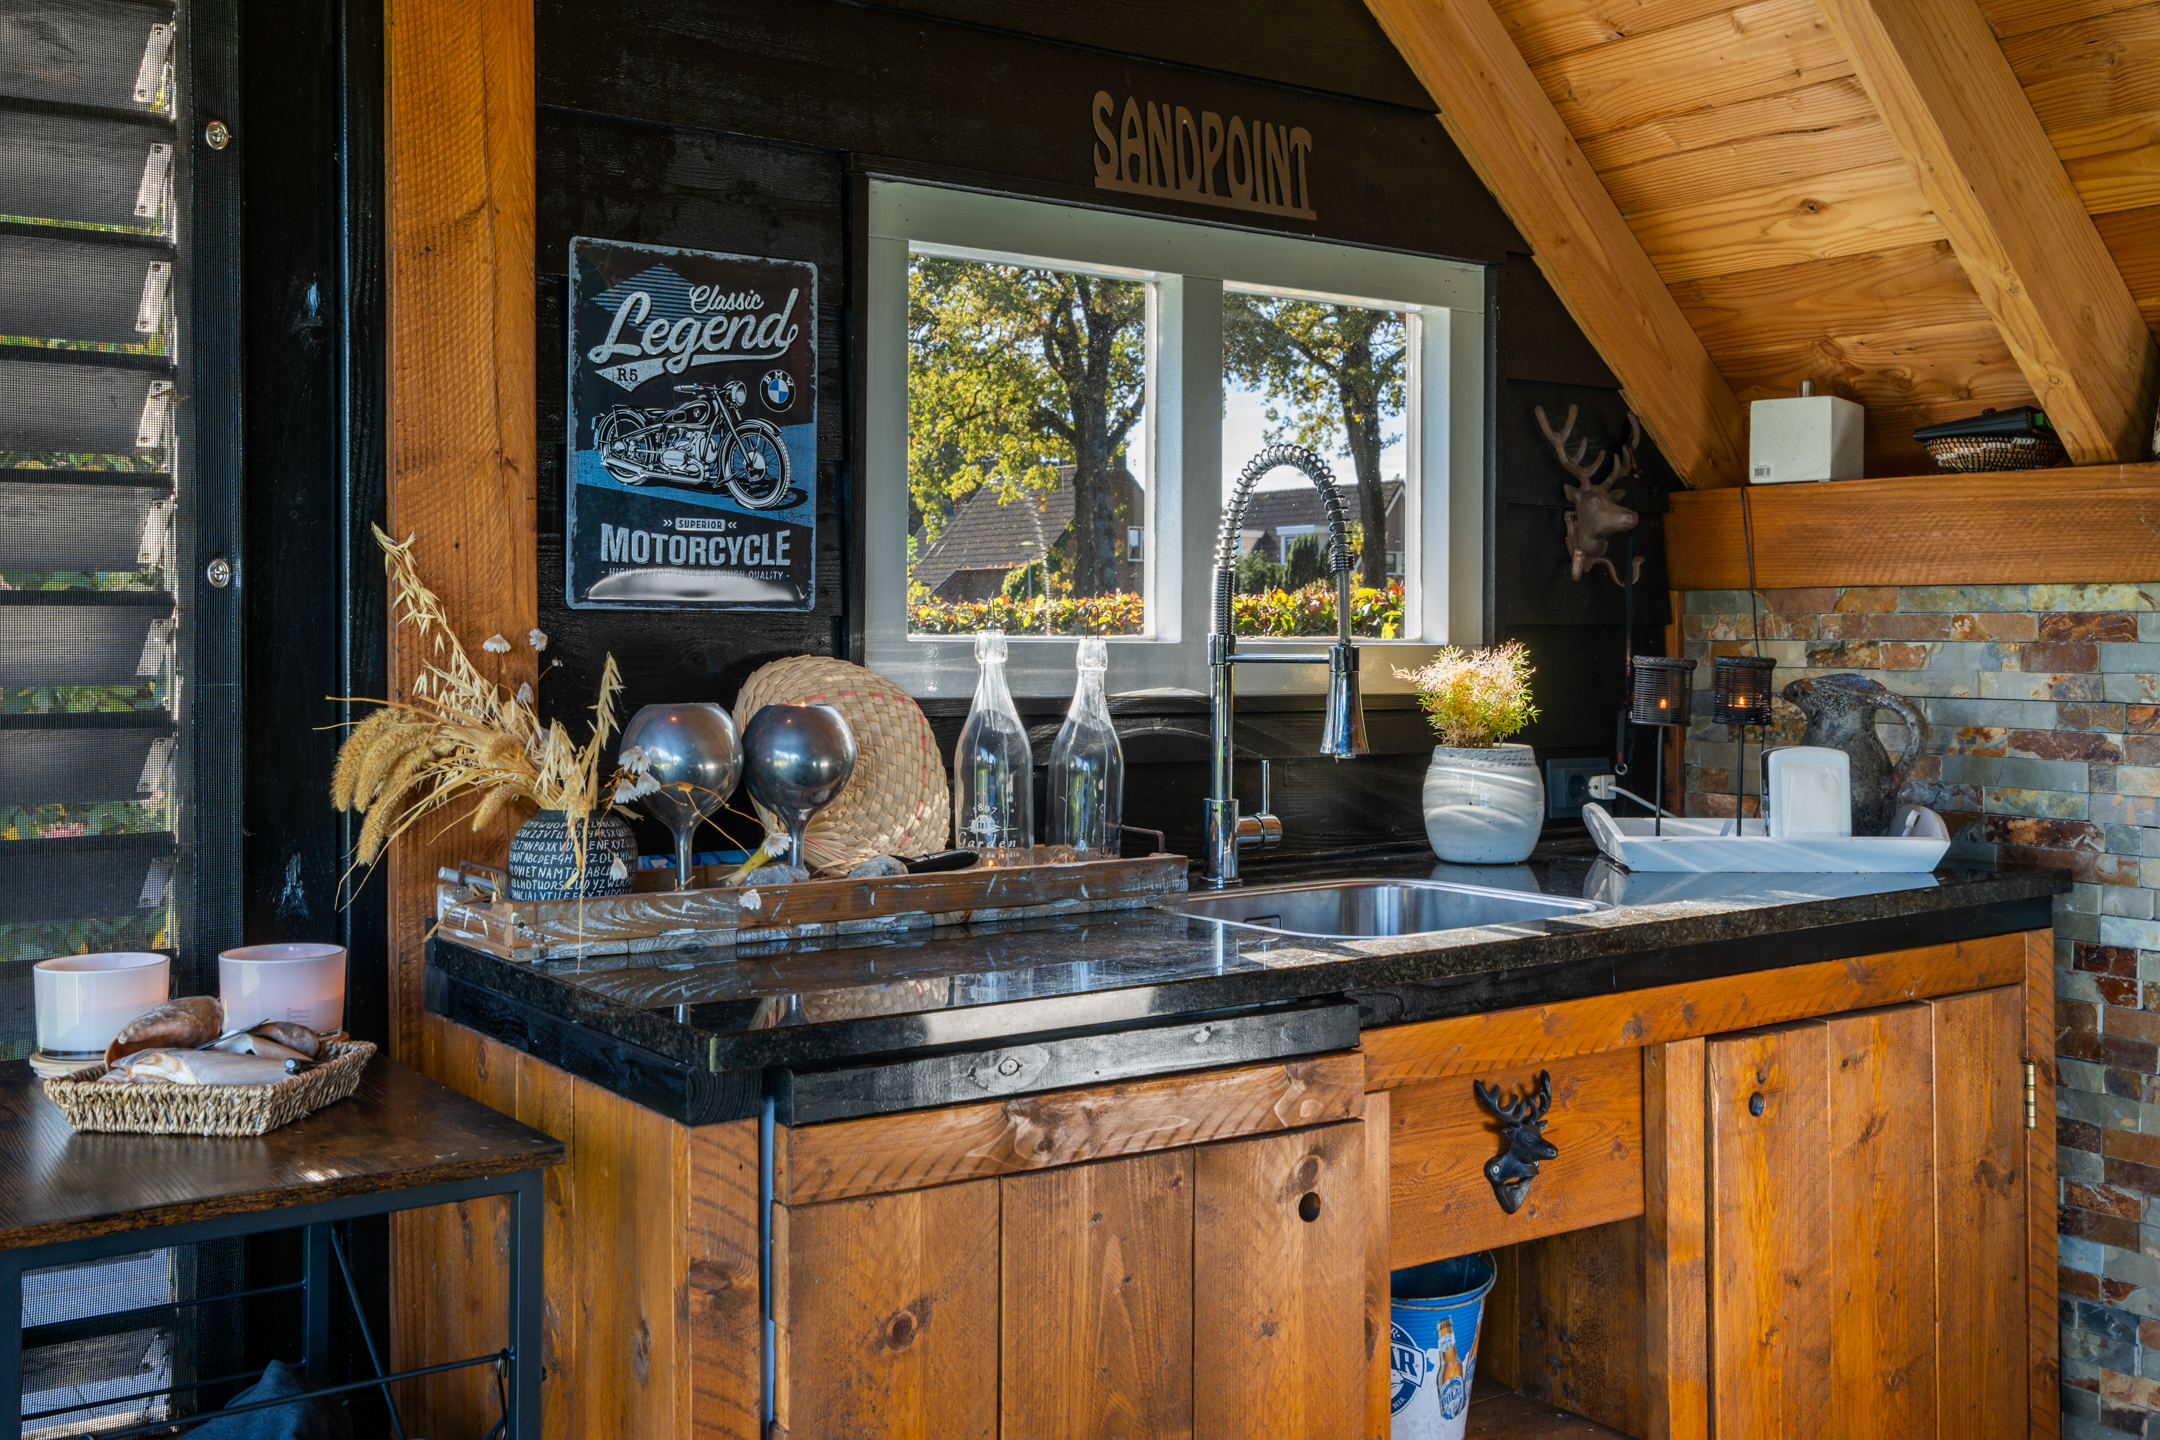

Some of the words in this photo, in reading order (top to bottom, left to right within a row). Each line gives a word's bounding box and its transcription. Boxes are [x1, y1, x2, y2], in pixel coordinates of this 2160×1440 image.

[1092, 90, 1314, 214] SANDPOINT
[688, 284, 765, 314] Classic
[587, 287, 800, 375] Legend
[617, 367, 639, 382] R5
[763, 371, 794, 387] BMW
[678, 519, 723, 530] SUPERIOR
[600, 522, 791, 568] MOTORCYCLE
[609, 567, 632, 577] HIGH
[635, 568, 701, 578] PERFORMANCE
[704, 569, 745, 579] THROUGH
[748, 570, 784, 580] QUALITY
[972, 803, 998, 815] 1897
[957, 831, 1017, 849] Garden
